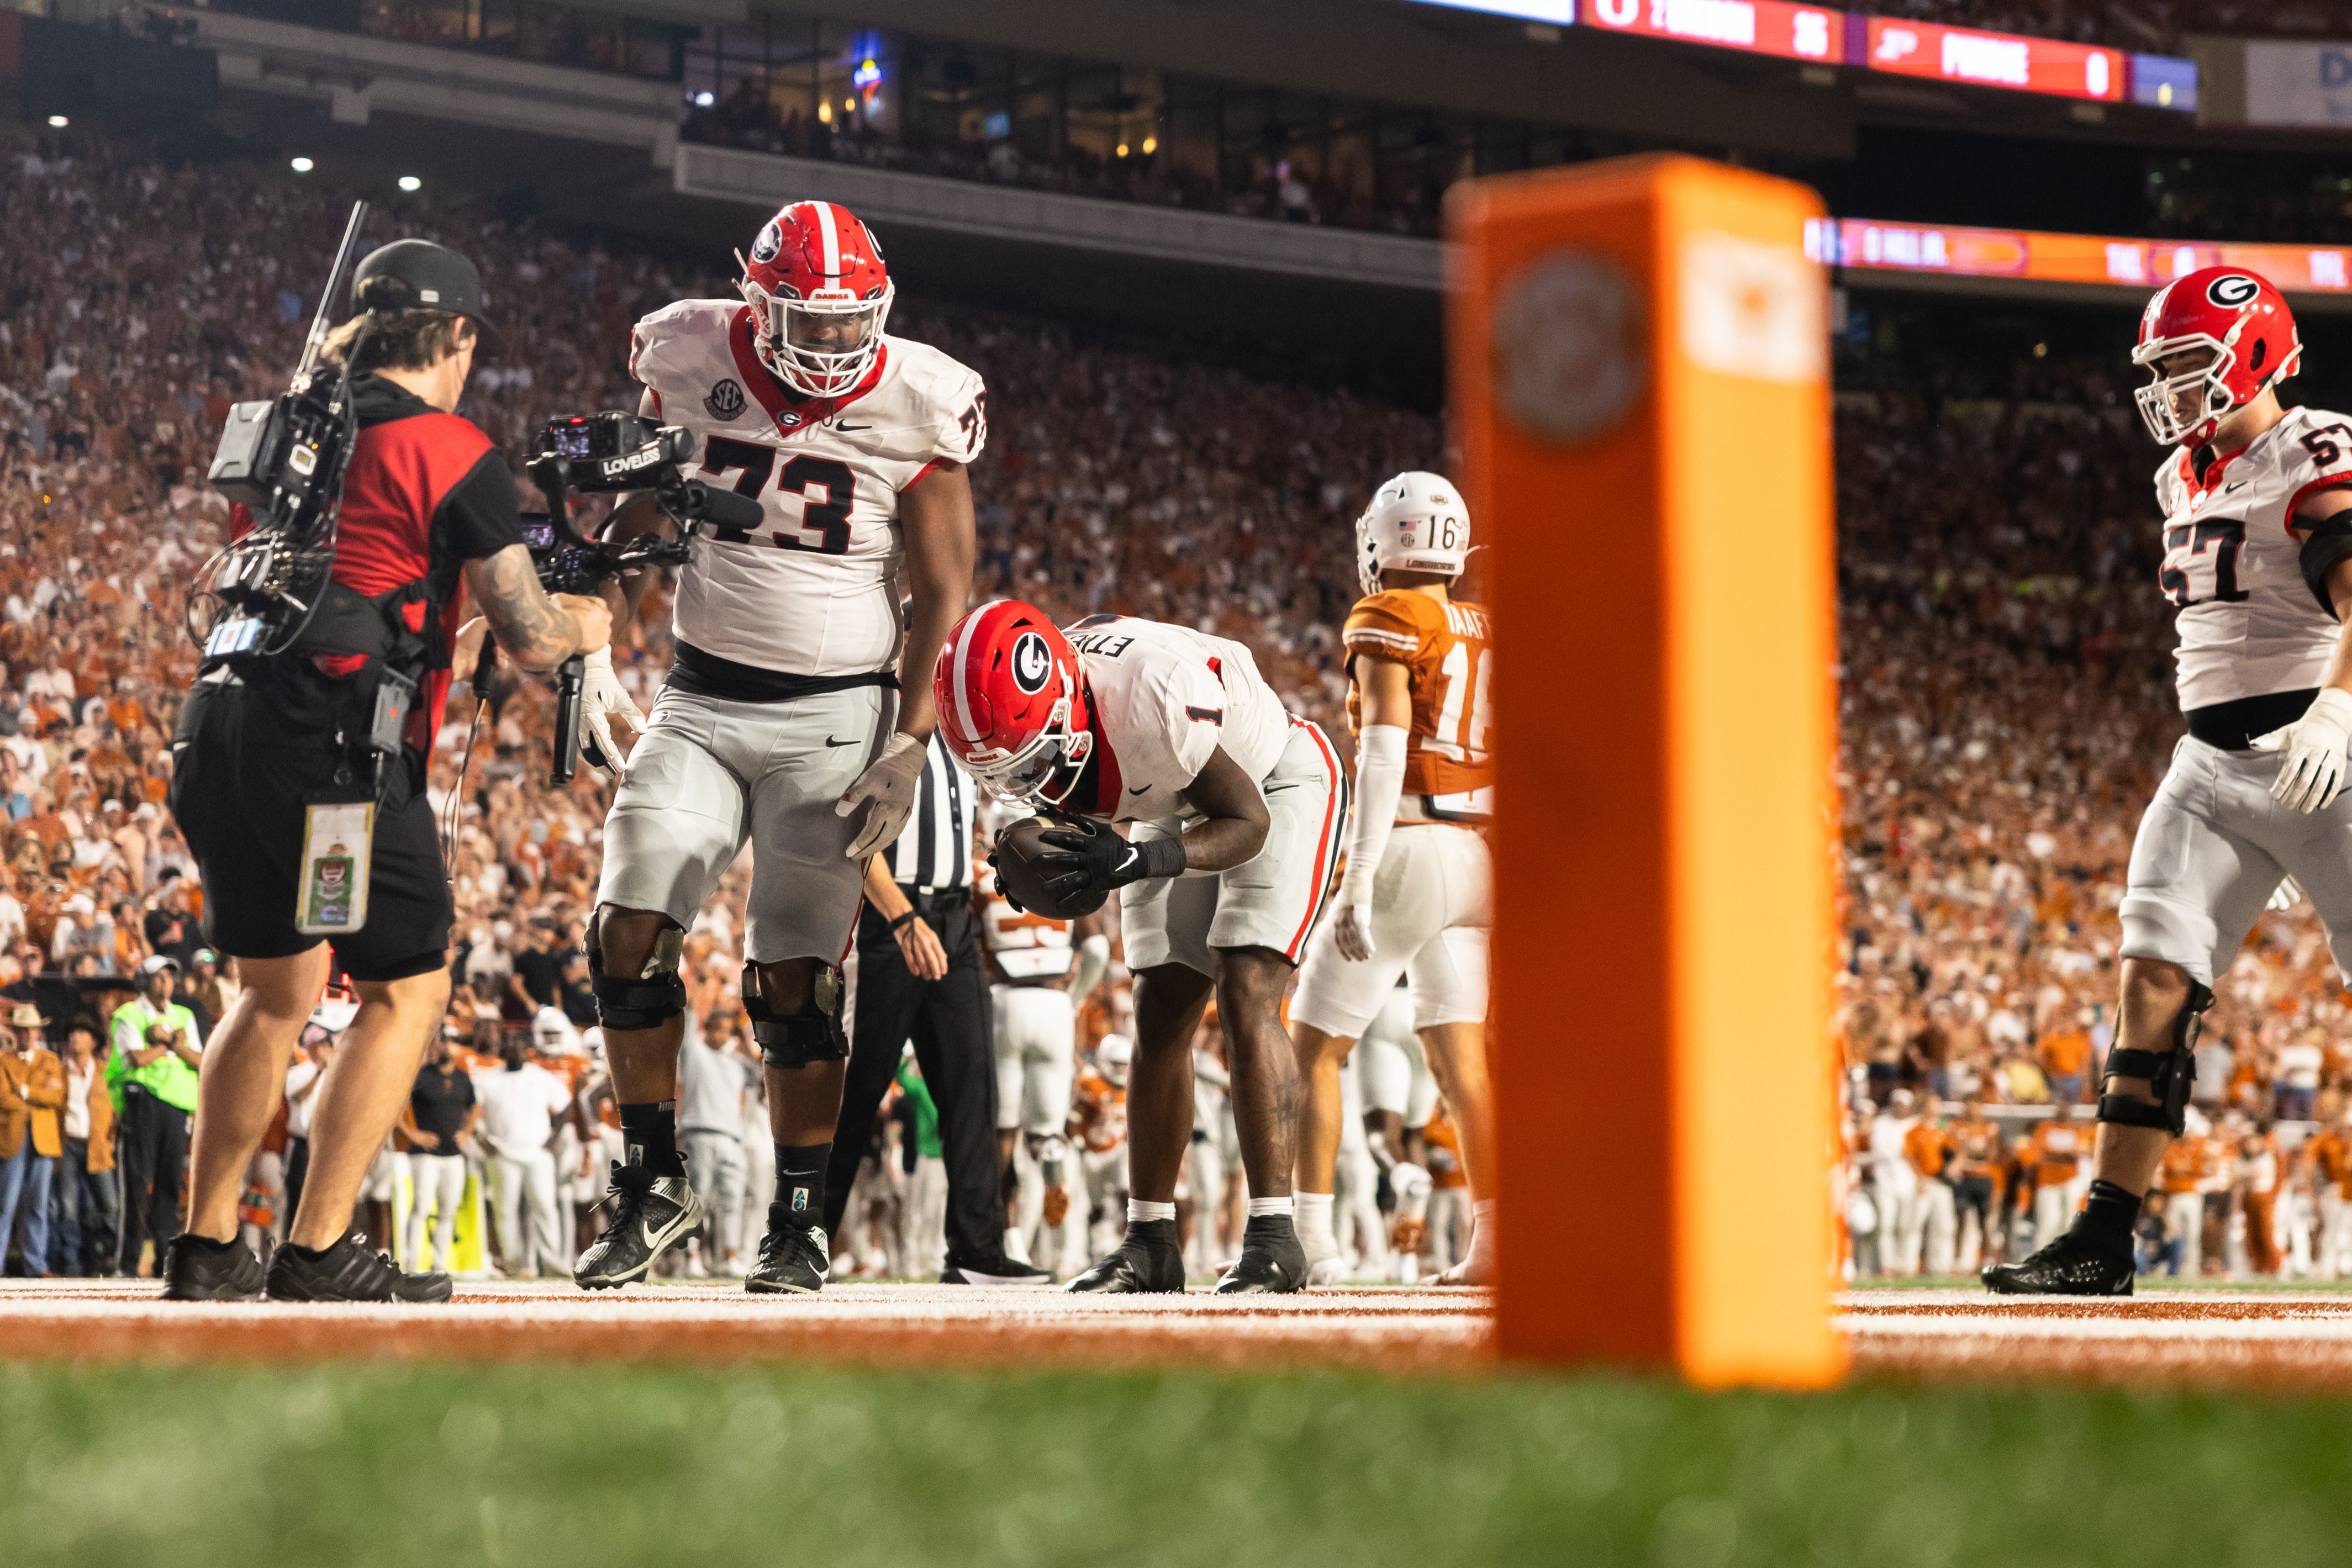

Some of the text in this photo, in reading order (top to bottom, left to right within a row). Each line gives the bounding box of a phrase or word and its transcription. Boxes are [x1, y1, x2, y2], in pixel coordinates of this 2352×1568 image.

[2209, 276, 2258, 306] G
[715, 381, 741, 410] SEC
[778, 410, 801, 426] G
[603, 447, 661, 475] LOVELESS
[699, 435, 856, 555] 73
[1428, 515, 1455, 550] 16
[2159, 517, 2249, 608] 57
[1014, 633, 1050, 692] G
[1186, 705, 1222, 727] 1
